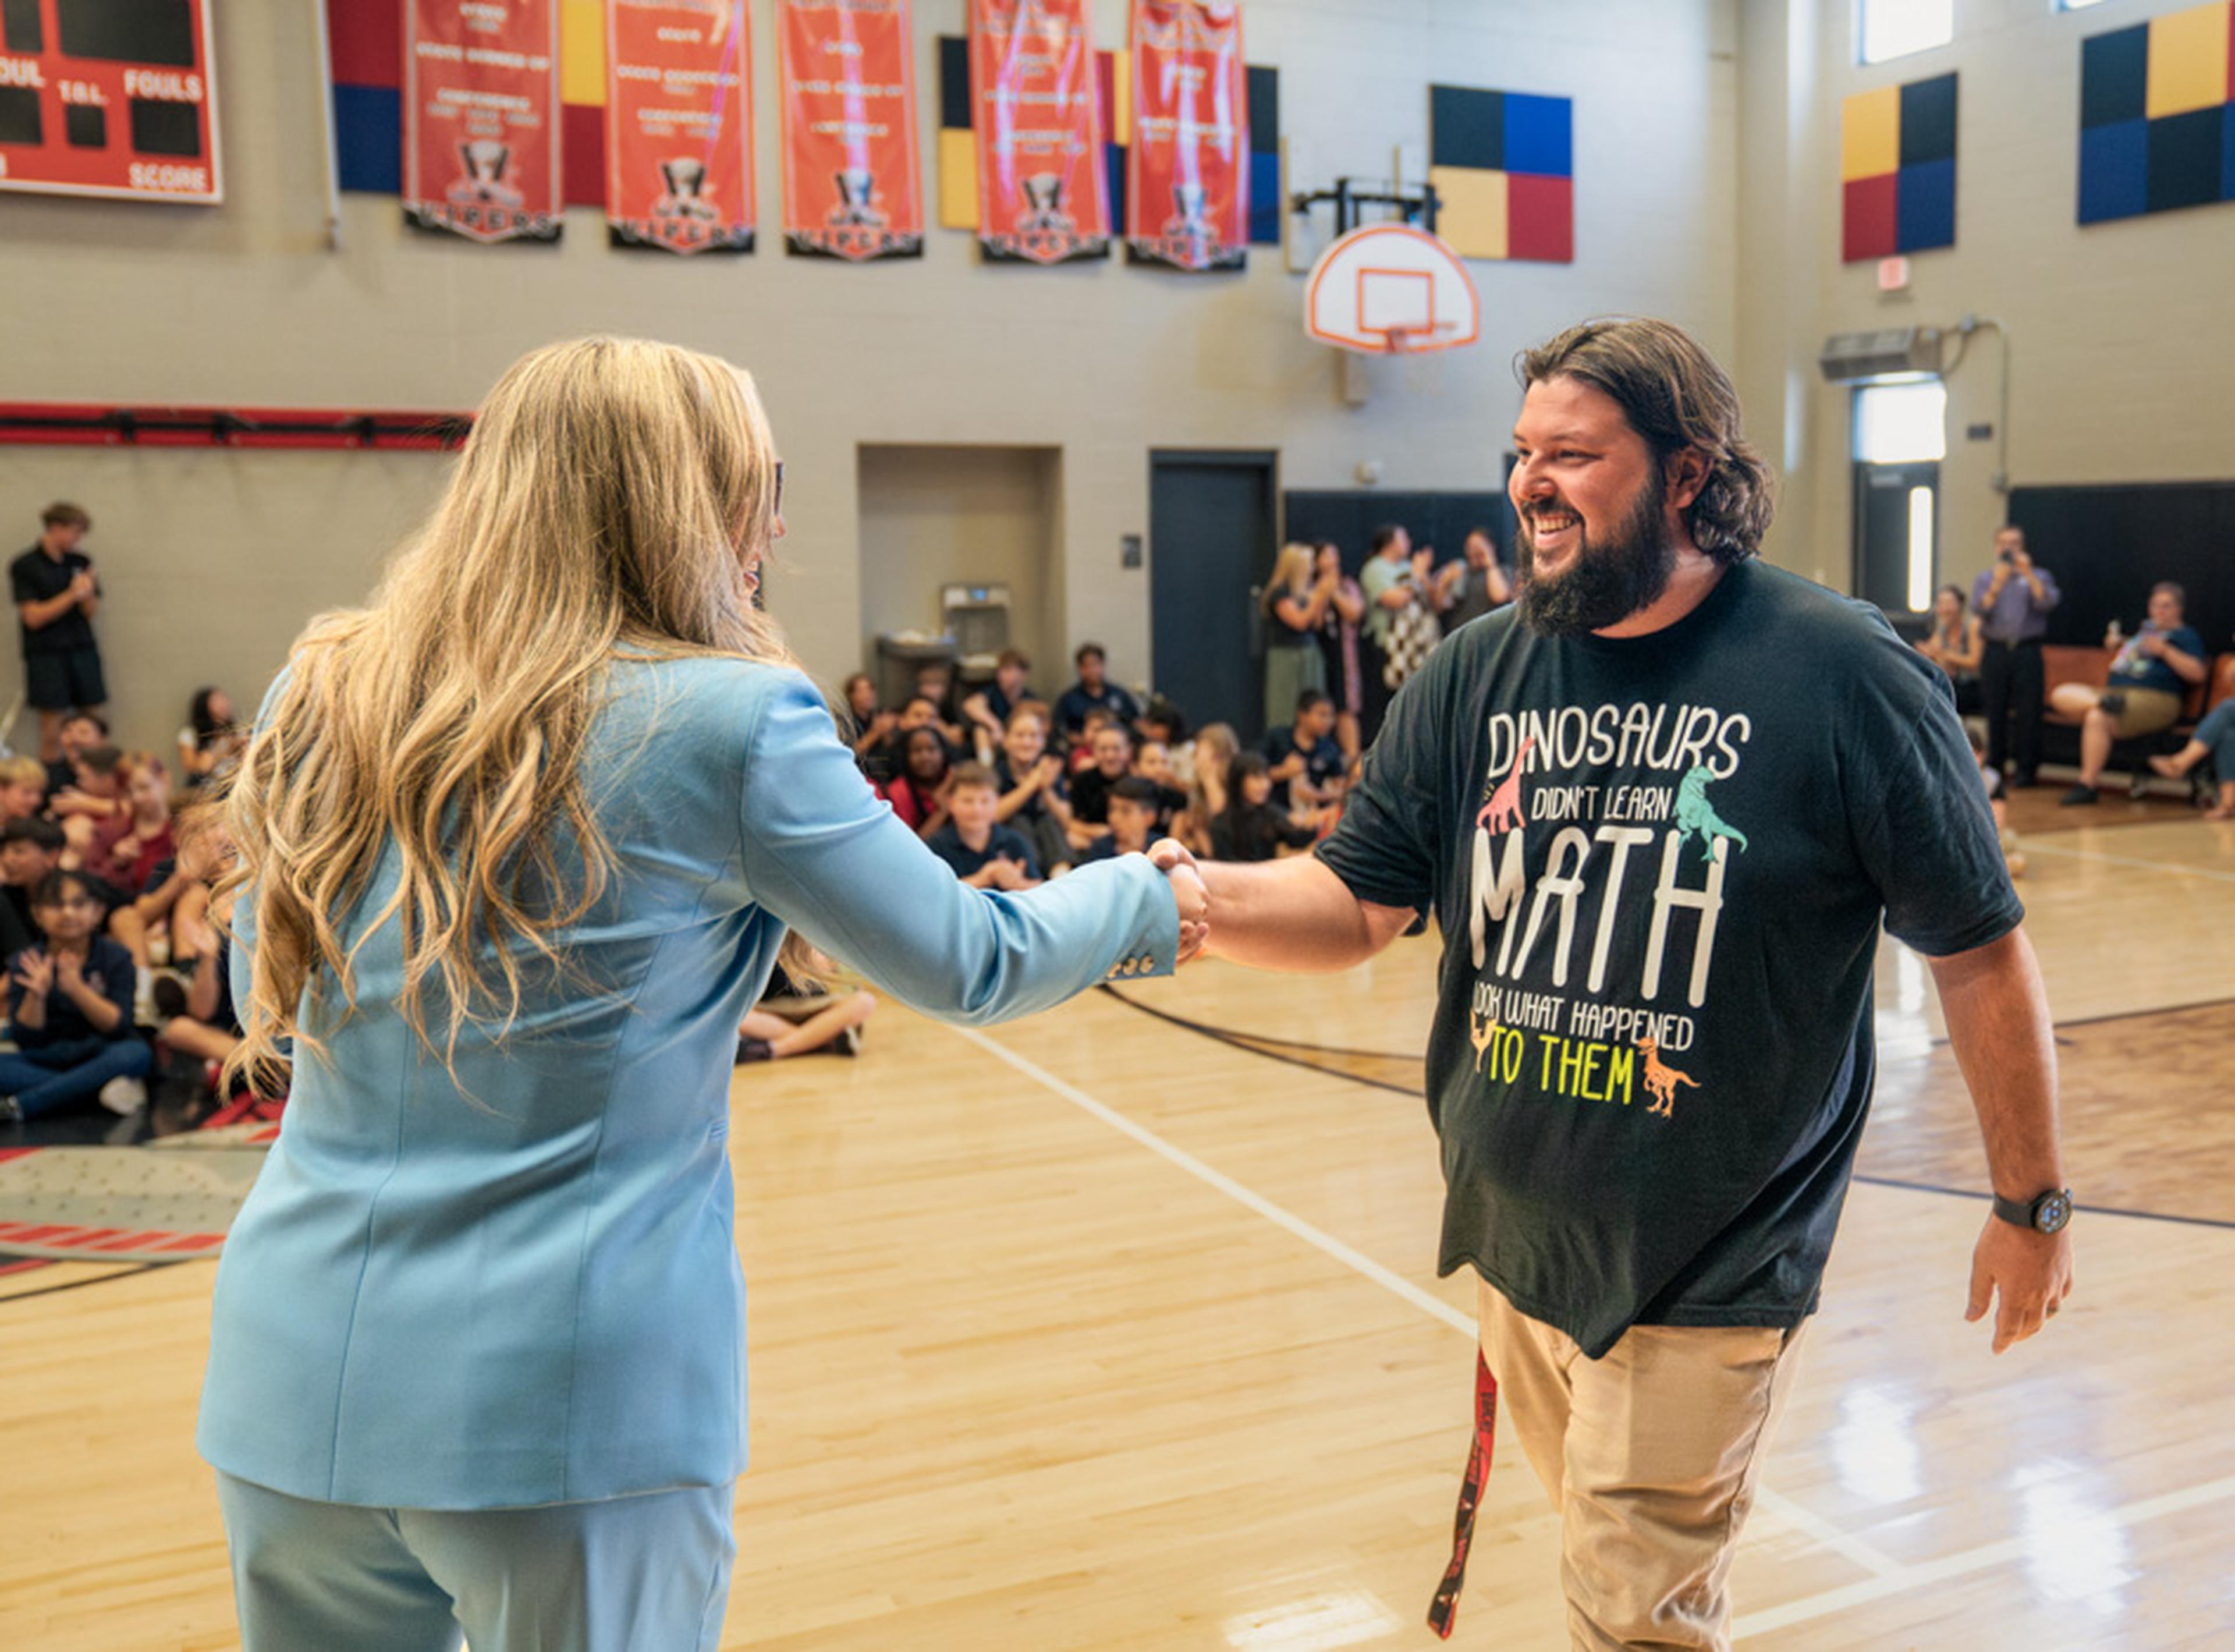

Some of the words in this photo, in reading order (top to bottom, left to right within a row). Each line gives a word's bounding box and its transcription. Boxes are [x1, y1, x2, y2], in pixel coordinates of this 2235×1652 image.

[0, 56, 47, 88] OUL
[123, 69, 203, 102] FOULS
[129, 162, 207, 192] SCORE
[417, 203, 556, 237] VIPERS
[1488, 702, 1751, 781] DINOSAURS
[1531, 785, 1599, 821] DIDN'T
[1603, 785, 1673, 821] LEARN
[1470, 826, 1729, 1008] MATH
[1505, 990, 1565, 1032] WHAT
[1569, 1000, 1694, 1051] HAPPENED
[1491, 1026, 1524, 1084] TO
[1538, 1034, 1634, 1105] THEM
